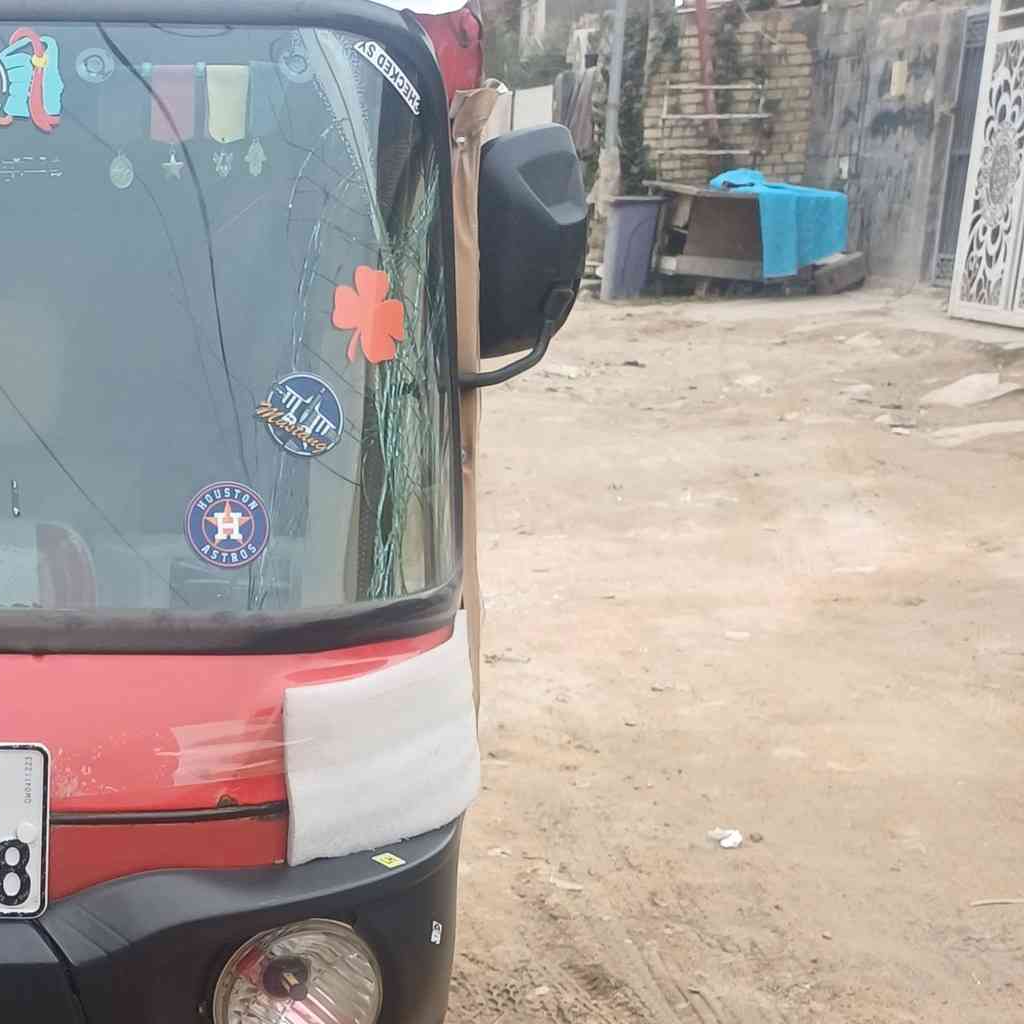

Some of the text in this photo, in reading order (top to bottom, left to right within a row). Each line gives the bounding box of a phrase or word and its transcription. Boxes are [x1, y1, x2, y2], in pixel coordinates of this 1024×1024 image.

[255, 400, 329, 454] Mustang
[197, 487, 258, 511] HOUSTON
[213, 512, 243, 540] H
[200, 543, 258, 563] ASTROS
